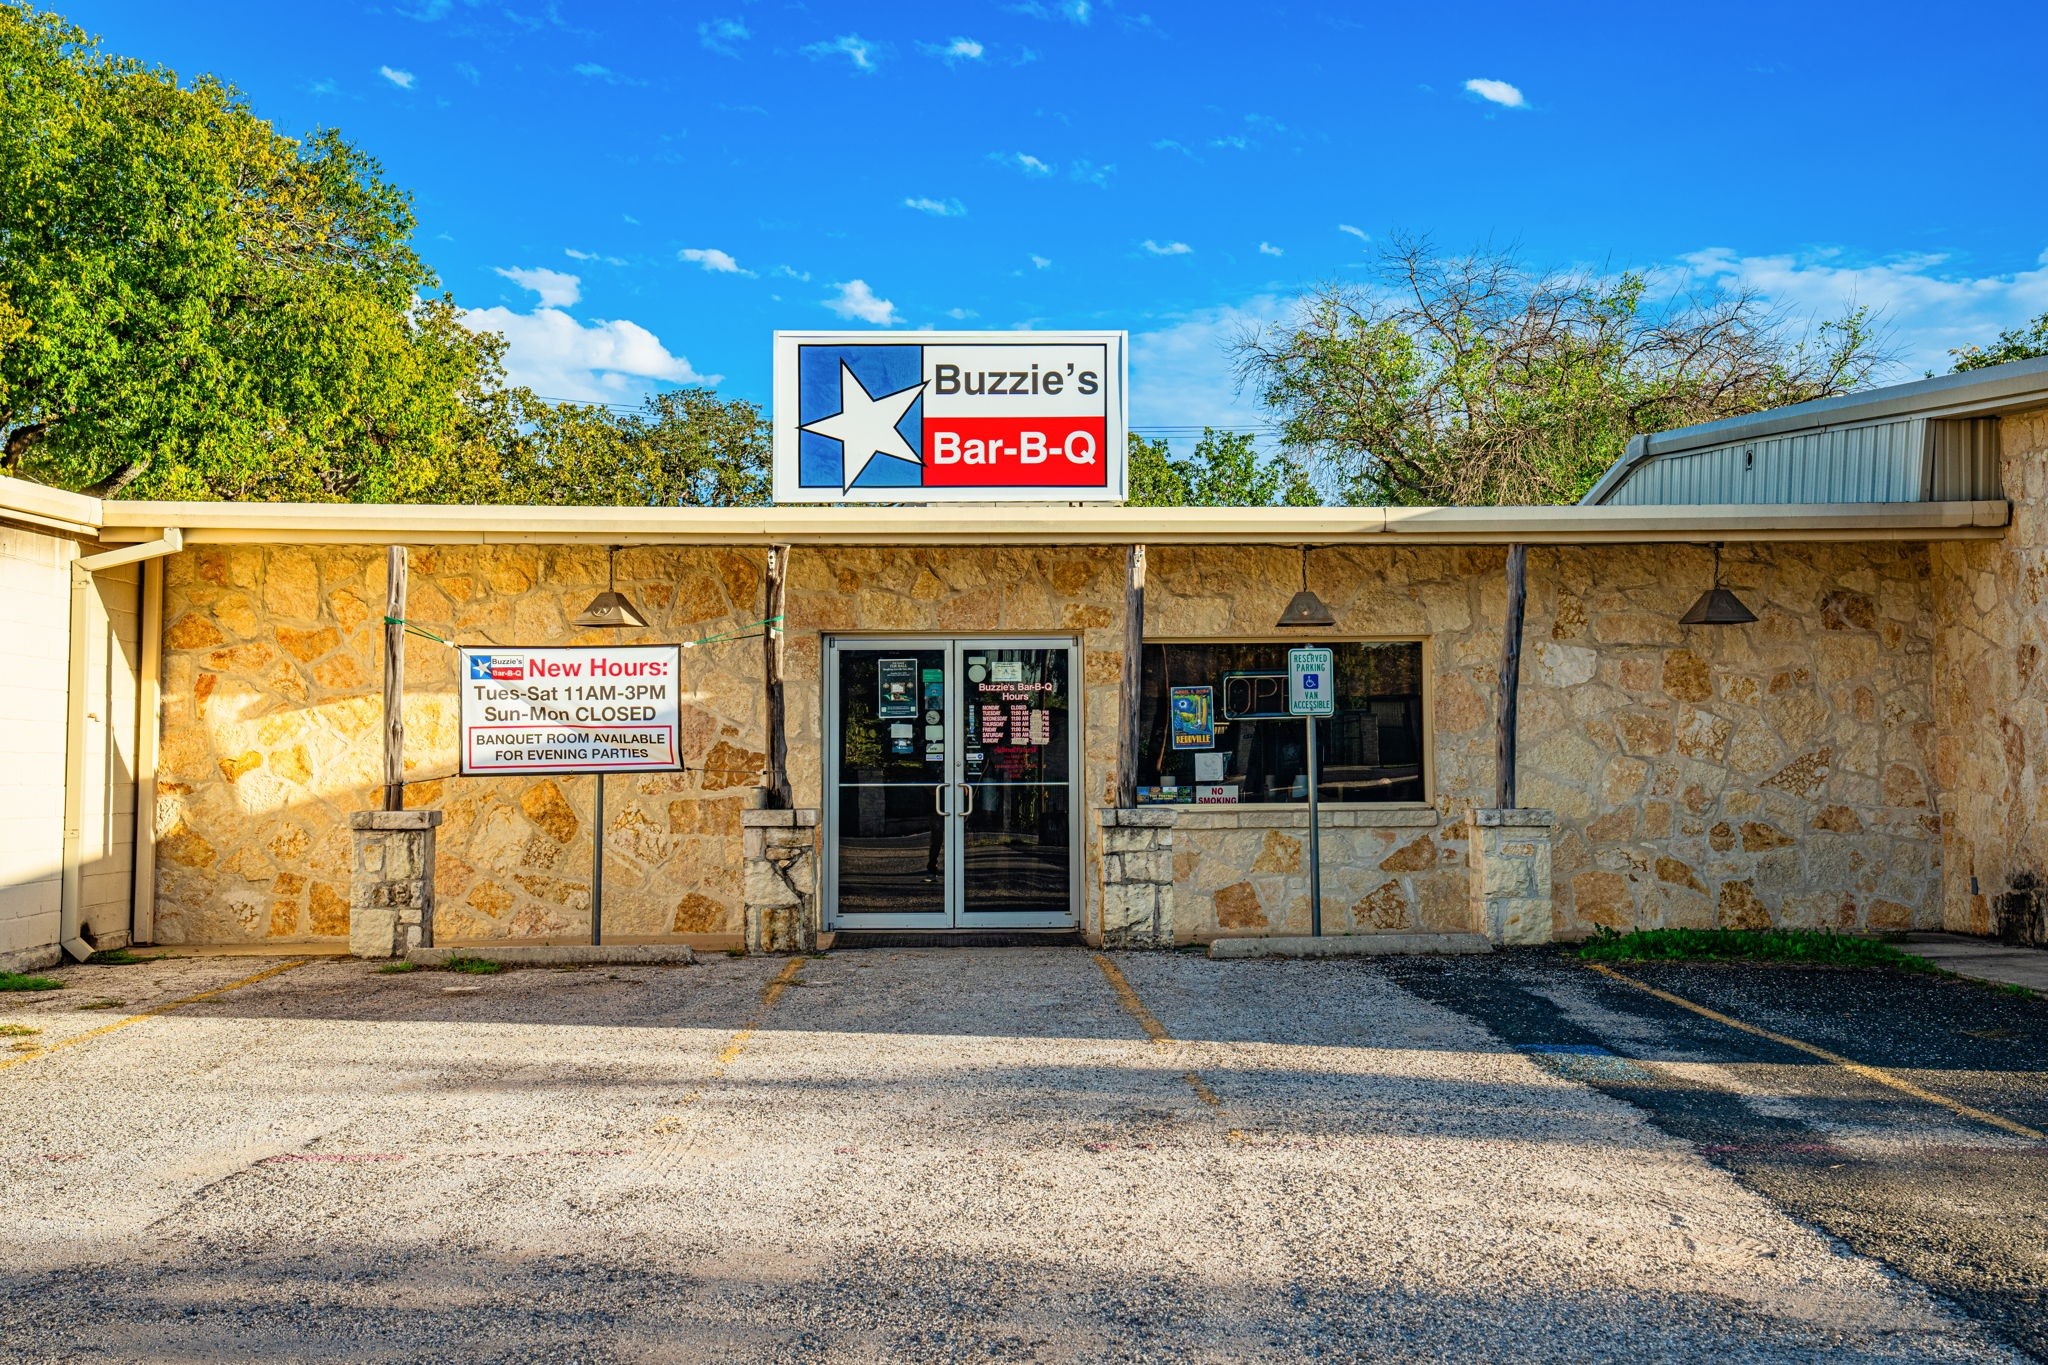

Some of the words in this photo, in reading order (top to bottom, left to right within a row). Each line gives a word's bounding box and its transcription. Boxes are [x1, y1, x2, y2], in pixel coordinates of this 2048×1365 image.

[935, 363, 1099, 395] Buzzie's
[934, 430, 1097, 465] Bar-B-Q
[1294, 654, 1327, 663] RESERVED
[529, 658, 582, 677] New
[590, 658, 668, 677] Hours:
[1296, 663, 1326, 672] PARKING
[492, 669, 522, 677] Bar-B-Q
[979, 683, 1015, 691] Buzzie's
[1017, 682, 1053, 691] Bar-B-Q
[474, 685, 558, 701] Tues-Sat
[564, 684, 666, 701] 11AM-3PM
[1002, 692, 1029, 701] Hours
[1304, 691, 1319, 700] VAN
[1293, 700, 1330, 709] ACCESSIBLE
[485, 707, 570, 722] Sun-Mon
[575, 706, 657, 722] CLOSED
[476, 733, 543, 746] BANQUET
[546, 733, 590, 744] ROOM
[593, 733, 665, 745] AVAILABLE
[495, 750, 524, 761] FOR
[527, 749, 588, 761] EVENING
[591, 748, 649, 759] PARTIES
[1211, 787, 1224, 795] NO
